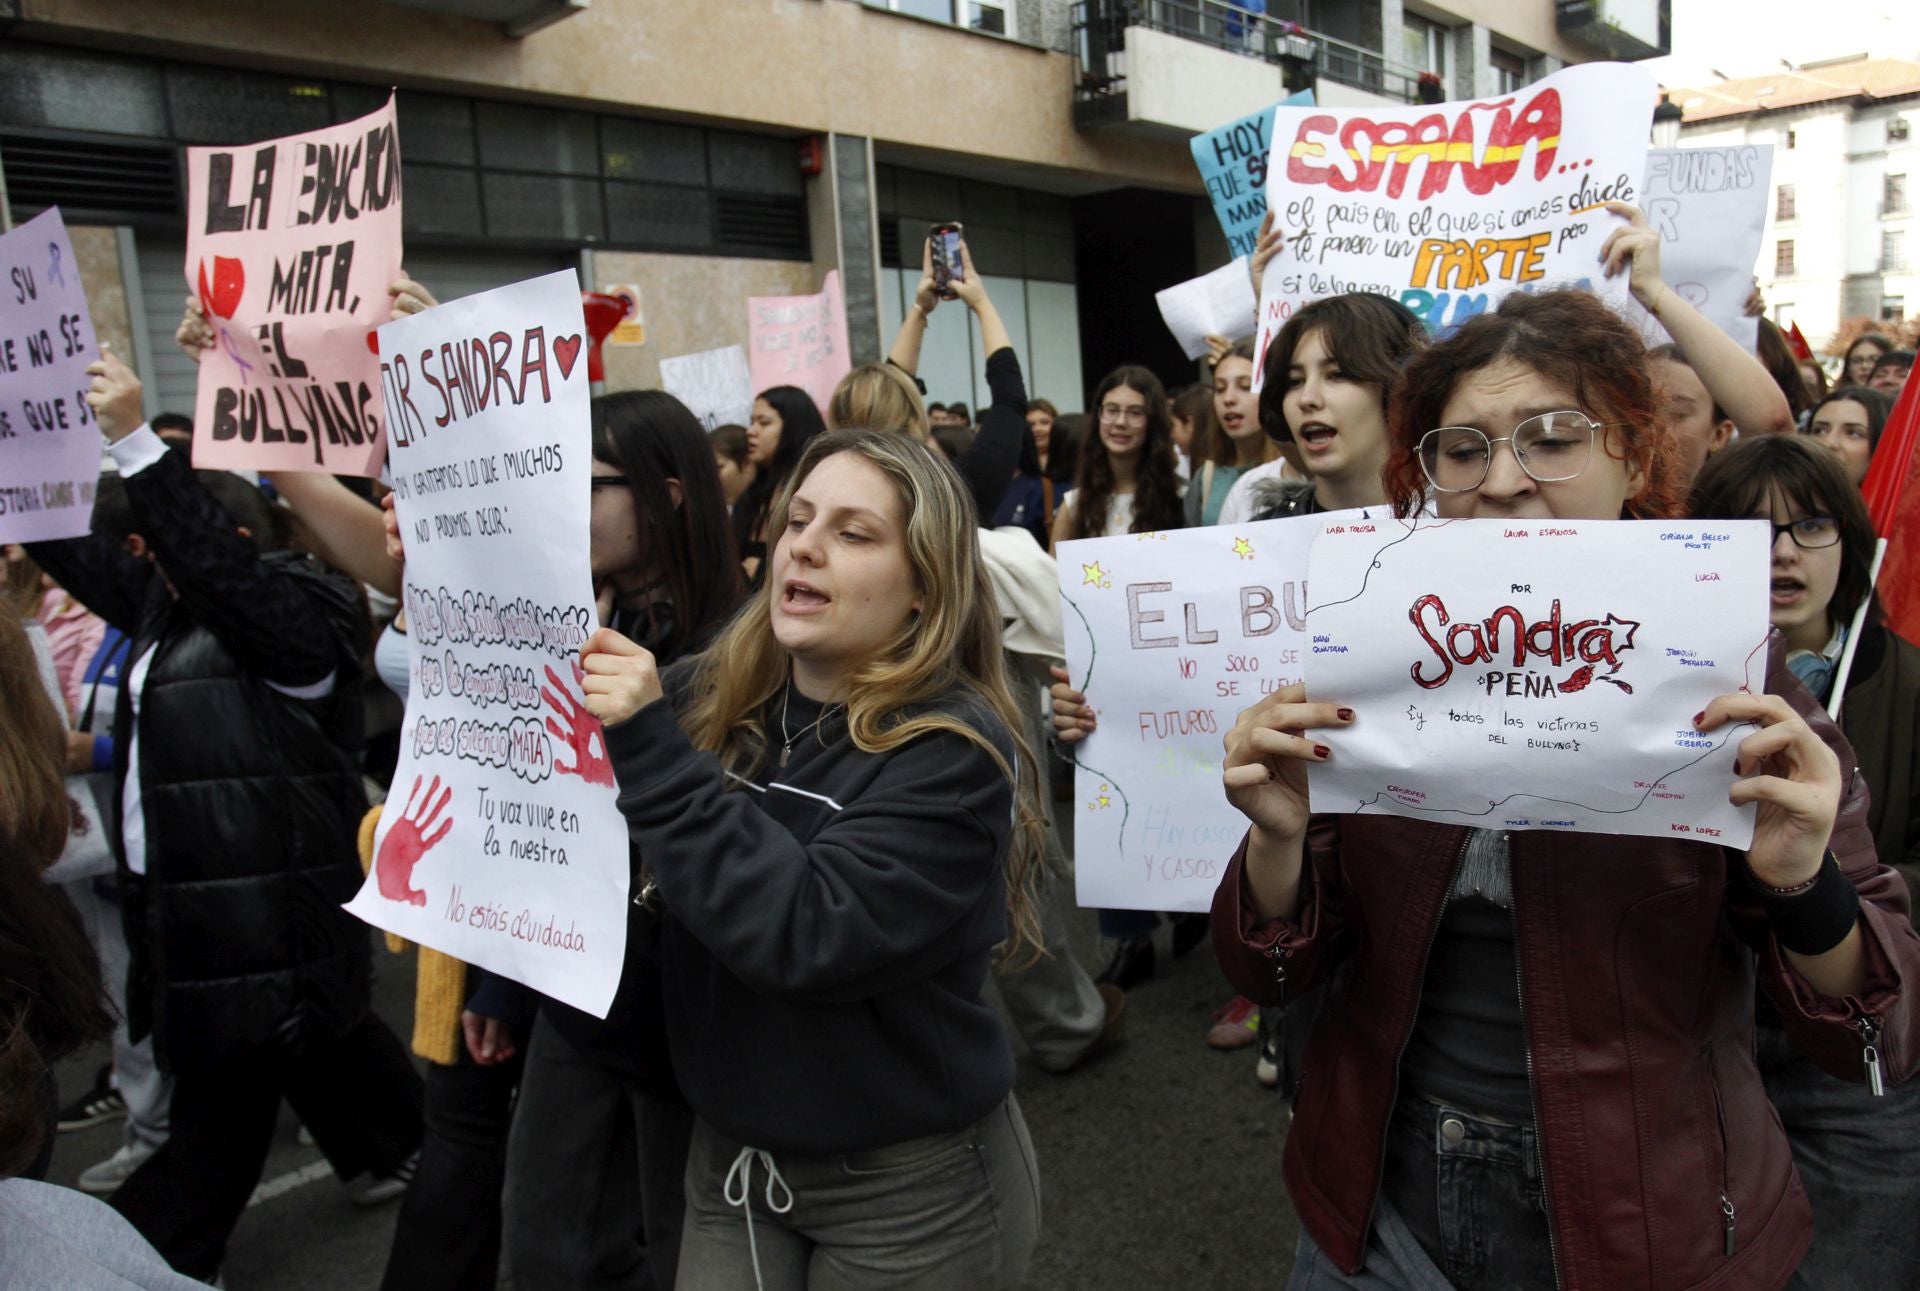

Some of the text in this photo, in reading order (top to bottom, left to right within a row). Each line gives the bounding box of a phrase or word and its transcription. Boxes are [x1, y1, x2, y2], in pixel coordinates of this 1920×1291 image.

[1212, 116, 1264, 166] HOY
[205, 145, 277, 235] LA
[1206, 166, 1248, 205] FUE
[1287, 196, 1315, 228] el
[1373, 207, 1400, 234] en
[1409, 206, 1432, 236] el
[1437, 210, 1481, 241] que
[1483, 206, 1506, 234] si
[1569, 173, 1633, 211] chicle
[268, 240, 361, 315] MATA,
[1287, 228, 1316, 263] te
[1319, 236, 1378, 265] ponen
[1383, 237, 1416, 259] un
[1410, 231, 1552, 290] PARTE
[11, 265, 37, 305] SU
[1282, 274, 1302, 295] si
[1309, 273, 1327, 295] le
[27, 329, 53, 368] NO
[60, 313, 84, 357] SE
[420, 326, 551, 428] SANDRA
[23, 398, 69, 432] QUE
[414, 463, 463, 496] GRITAMOS
[464, 460, 480, 488] LO
[480, 456, 500, 485] QUE
[504, 443, 564, 481] MUCHOS
[415, 518, 430, 544] NO
[435, 510, 472, 540] PUDIMOS
[1511, 583, 1532, 594] POR
[1126, 582, 1218, 649] EL
[1409, 594, 1617, 690] Sandra
[1178, 649, 1299, 679] NO SOLO SE
[1216, 681, 1240, 698] SE
[1485, 670, 1557, 699] PEÑA
[1139, 709, 1217, 742] FUTUROS
[1448, 708, 1485, 725] todas
[1503, 710, 1524, 729] las
[511, 727, 545, 767] MATA
[1488, 734, 1508, 746] DEL
[477, 787, 579, 834] Tu voz vive en
[483, 824, 568, 866] la nuestra
[1696, 827, 1722, 837] LOPEZ
[1144, 854, 1217, 882] Y CASOS
[445, 883, 465, 923] No
[510, 908, 586, 953] olvidada
